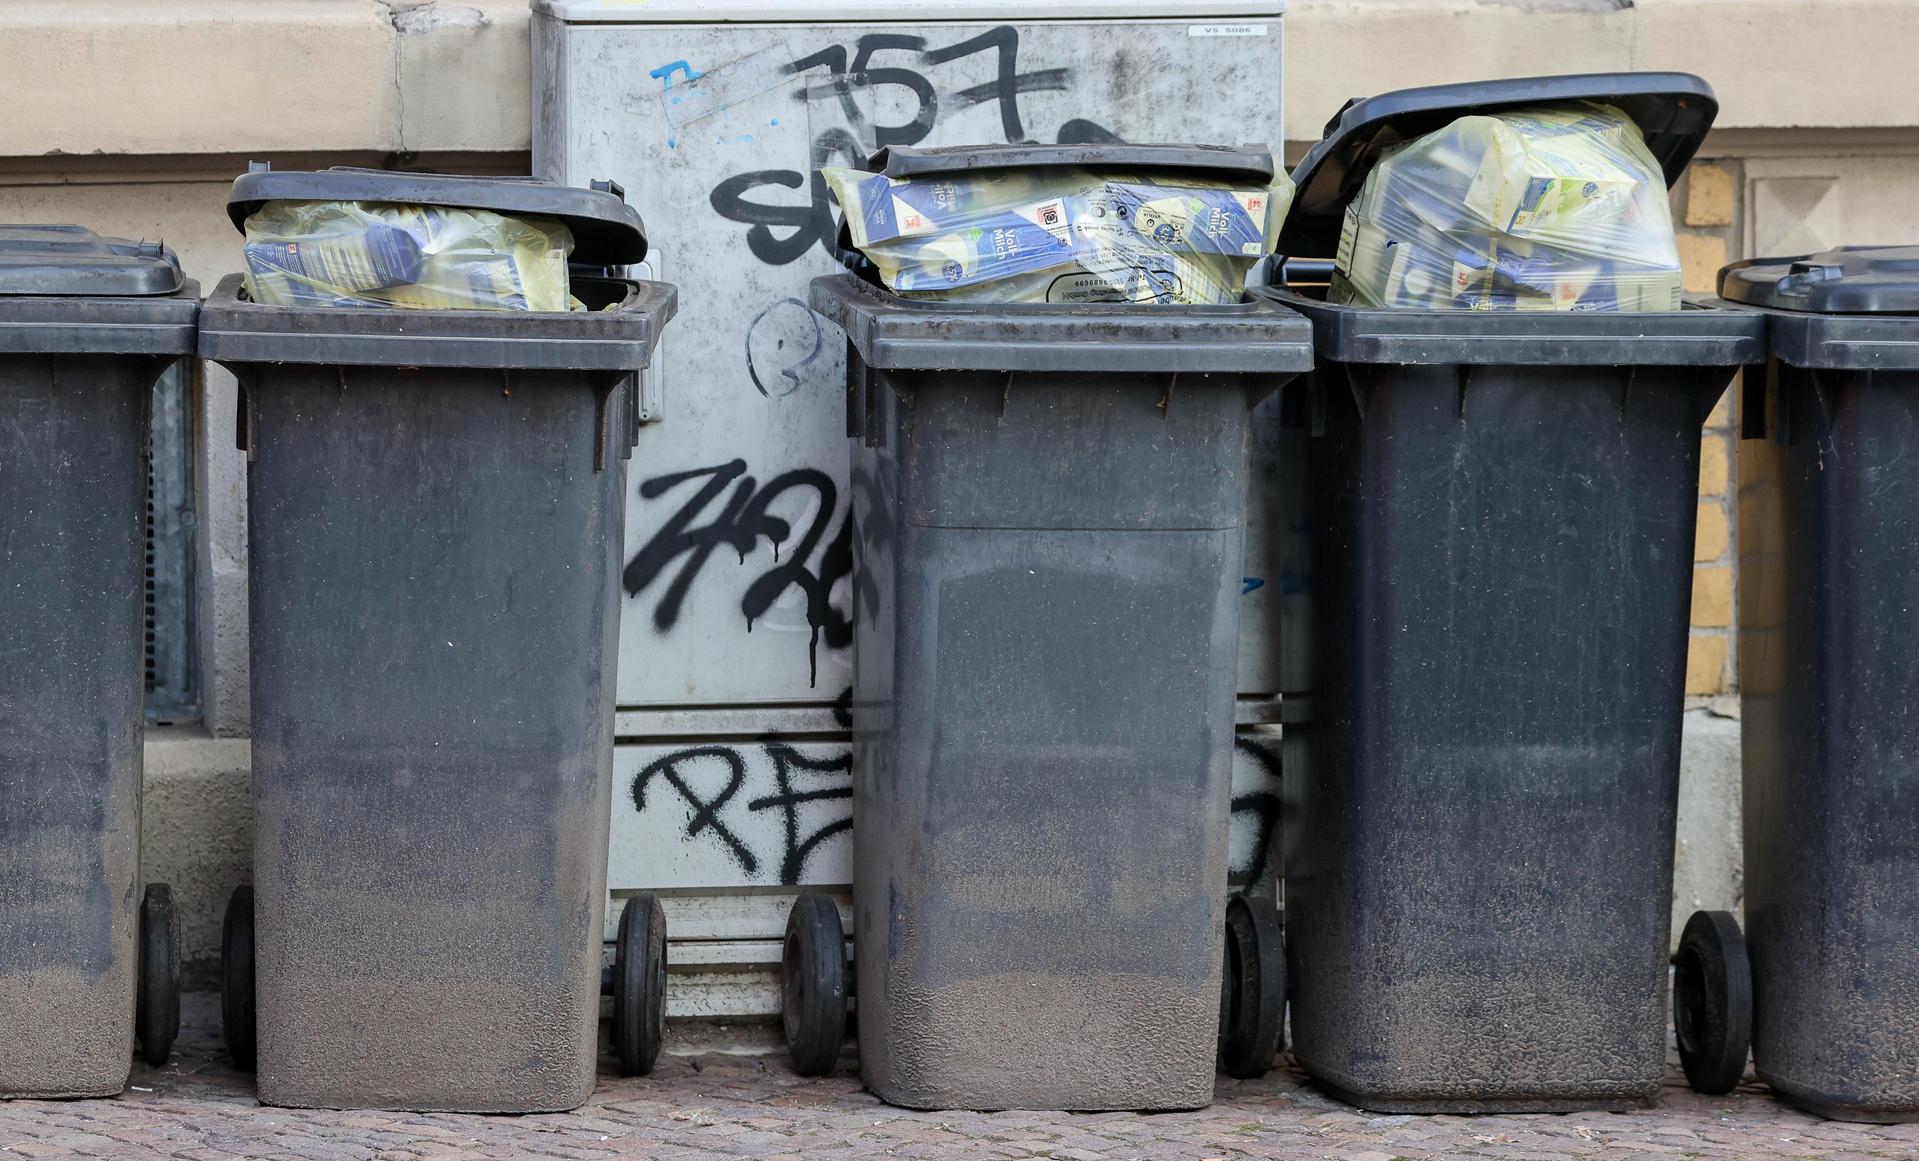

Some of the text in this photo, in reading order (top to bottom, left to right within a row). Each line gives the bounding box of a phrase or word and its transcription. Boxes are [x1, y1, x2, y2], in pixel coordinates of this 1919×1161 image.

[1208, 207, 1221, 240] Milch
[993, 228, 1006, 260] Milch
[1005, 229, 1018, 257] Voll-
